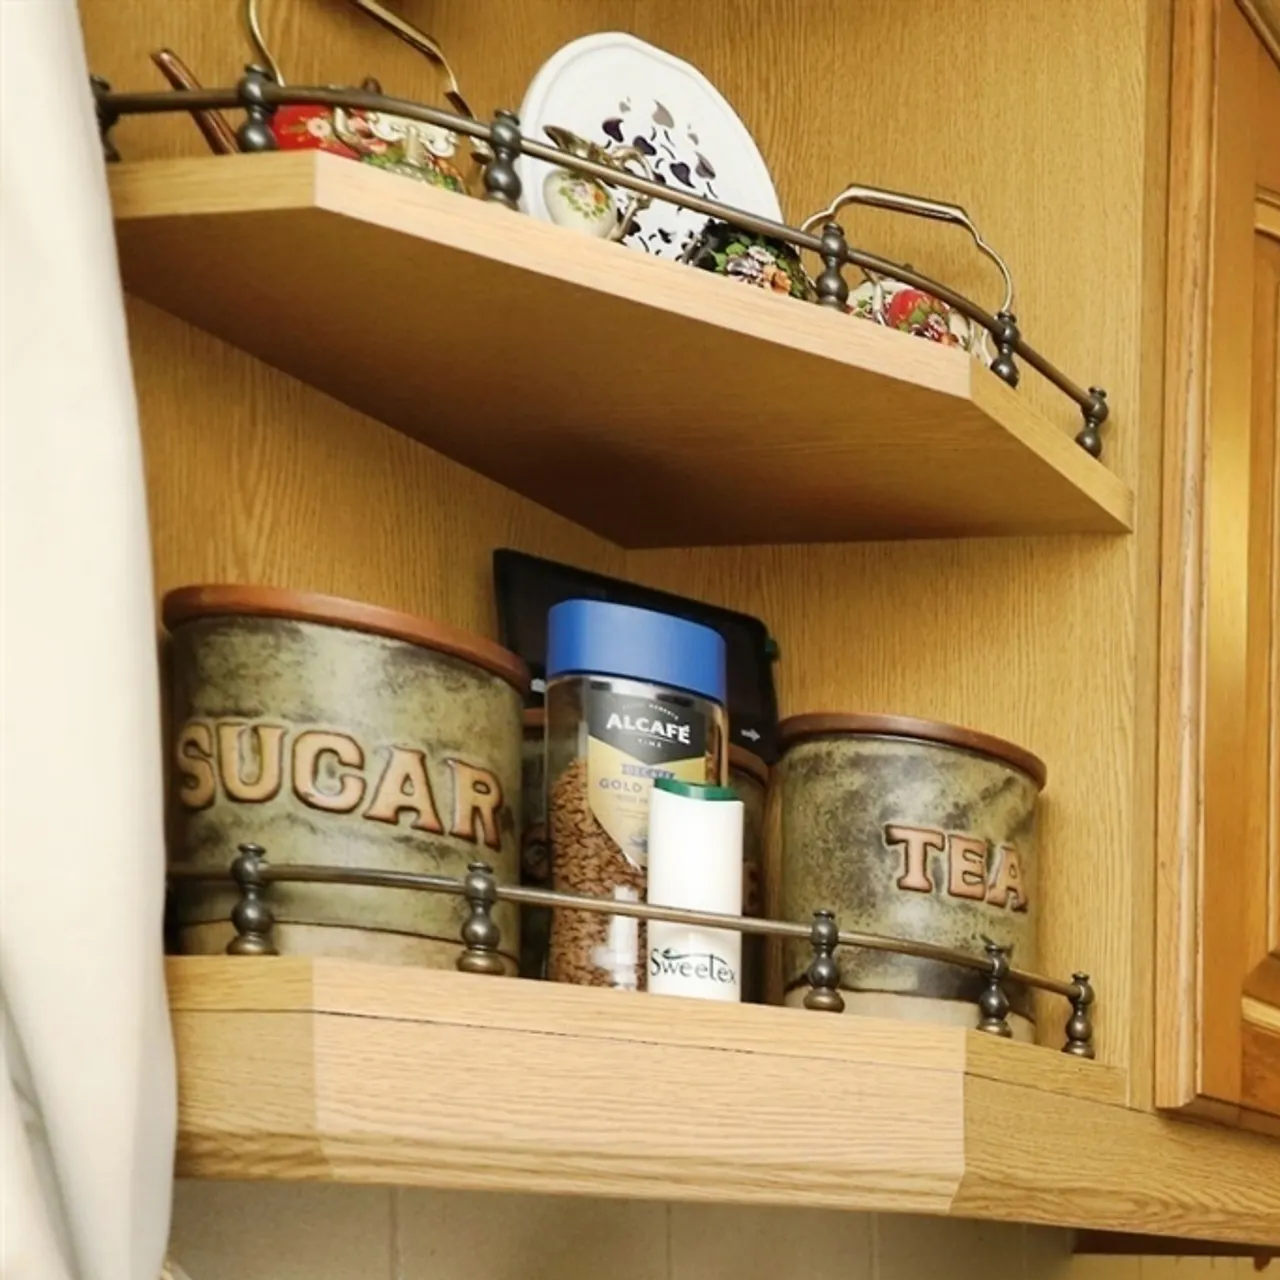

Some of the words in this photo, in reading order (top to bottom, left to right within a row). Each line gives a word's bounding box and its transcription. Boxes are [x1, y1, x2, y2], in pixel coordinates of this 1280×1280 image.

[606, 713, 691, 745] ALCAFÉ
[178, 717, 504, 852] SUGAR
[599, 778, 643, 794] GOLD
[885, 823, 1028, 914] TEA
[650, 947, 737, 985] Sweetex
